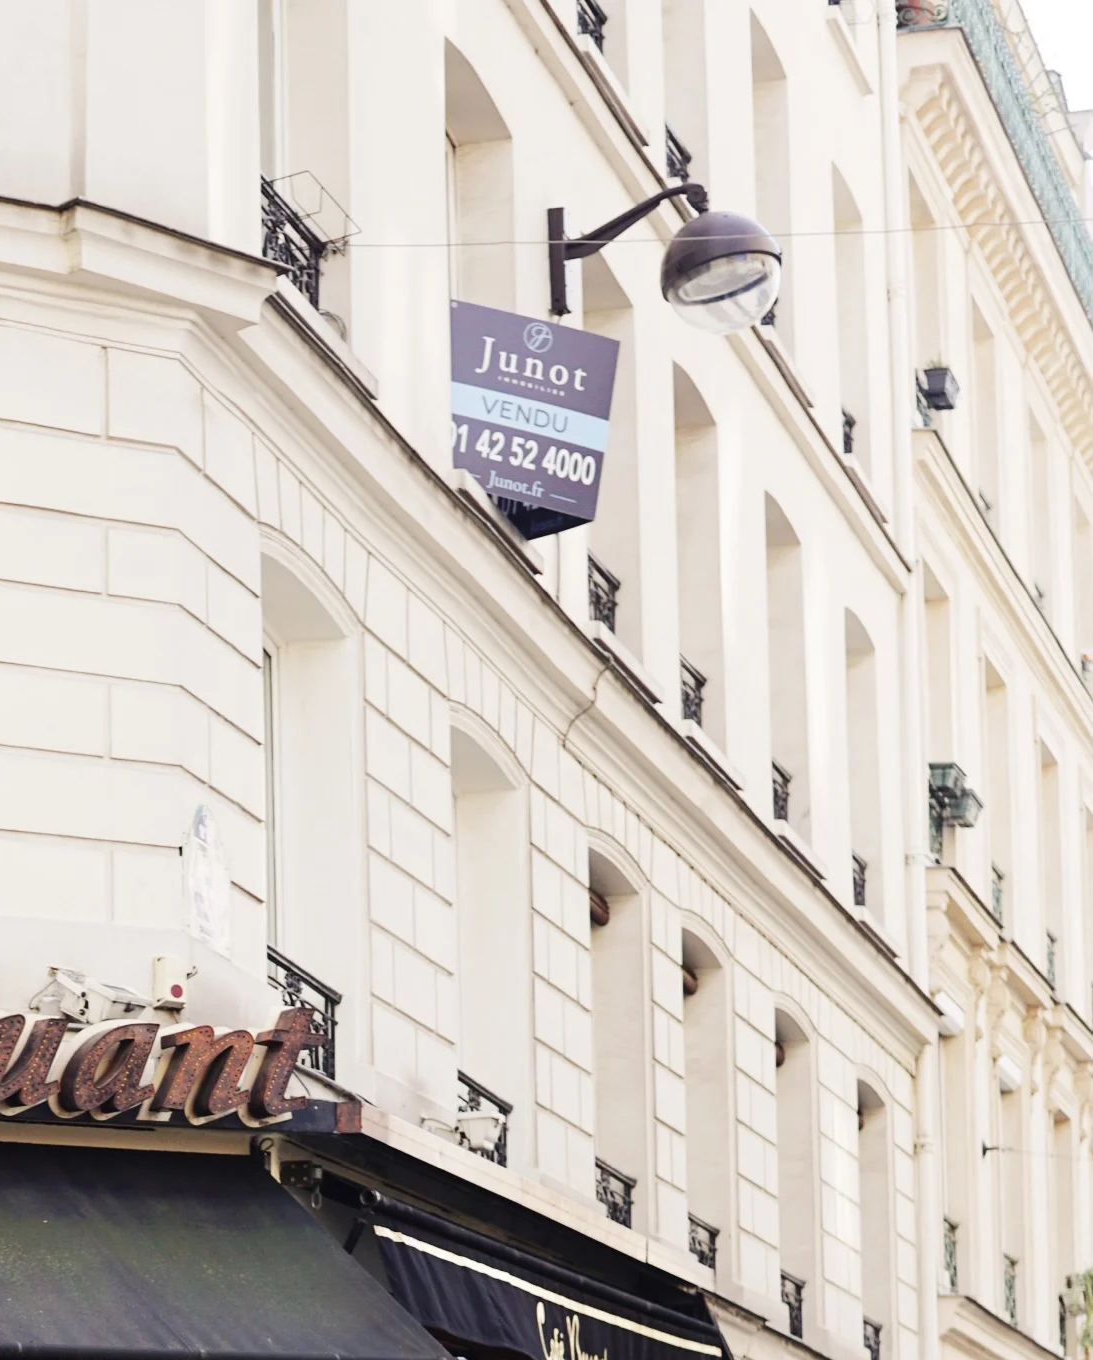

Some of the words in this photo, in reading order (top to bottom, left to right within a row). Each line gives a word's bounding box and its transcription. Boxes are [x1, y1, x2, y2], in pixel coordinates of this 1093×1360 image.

[474, 336, 587, 391] Junot
[481, 396, 569, 433] VENDU
[475, 429, 505, 462] 42
[509, 436, 538, 470] 52
[542, 445, 596, 485] 4000
[486, 470, 544, 499] Junot.fr
